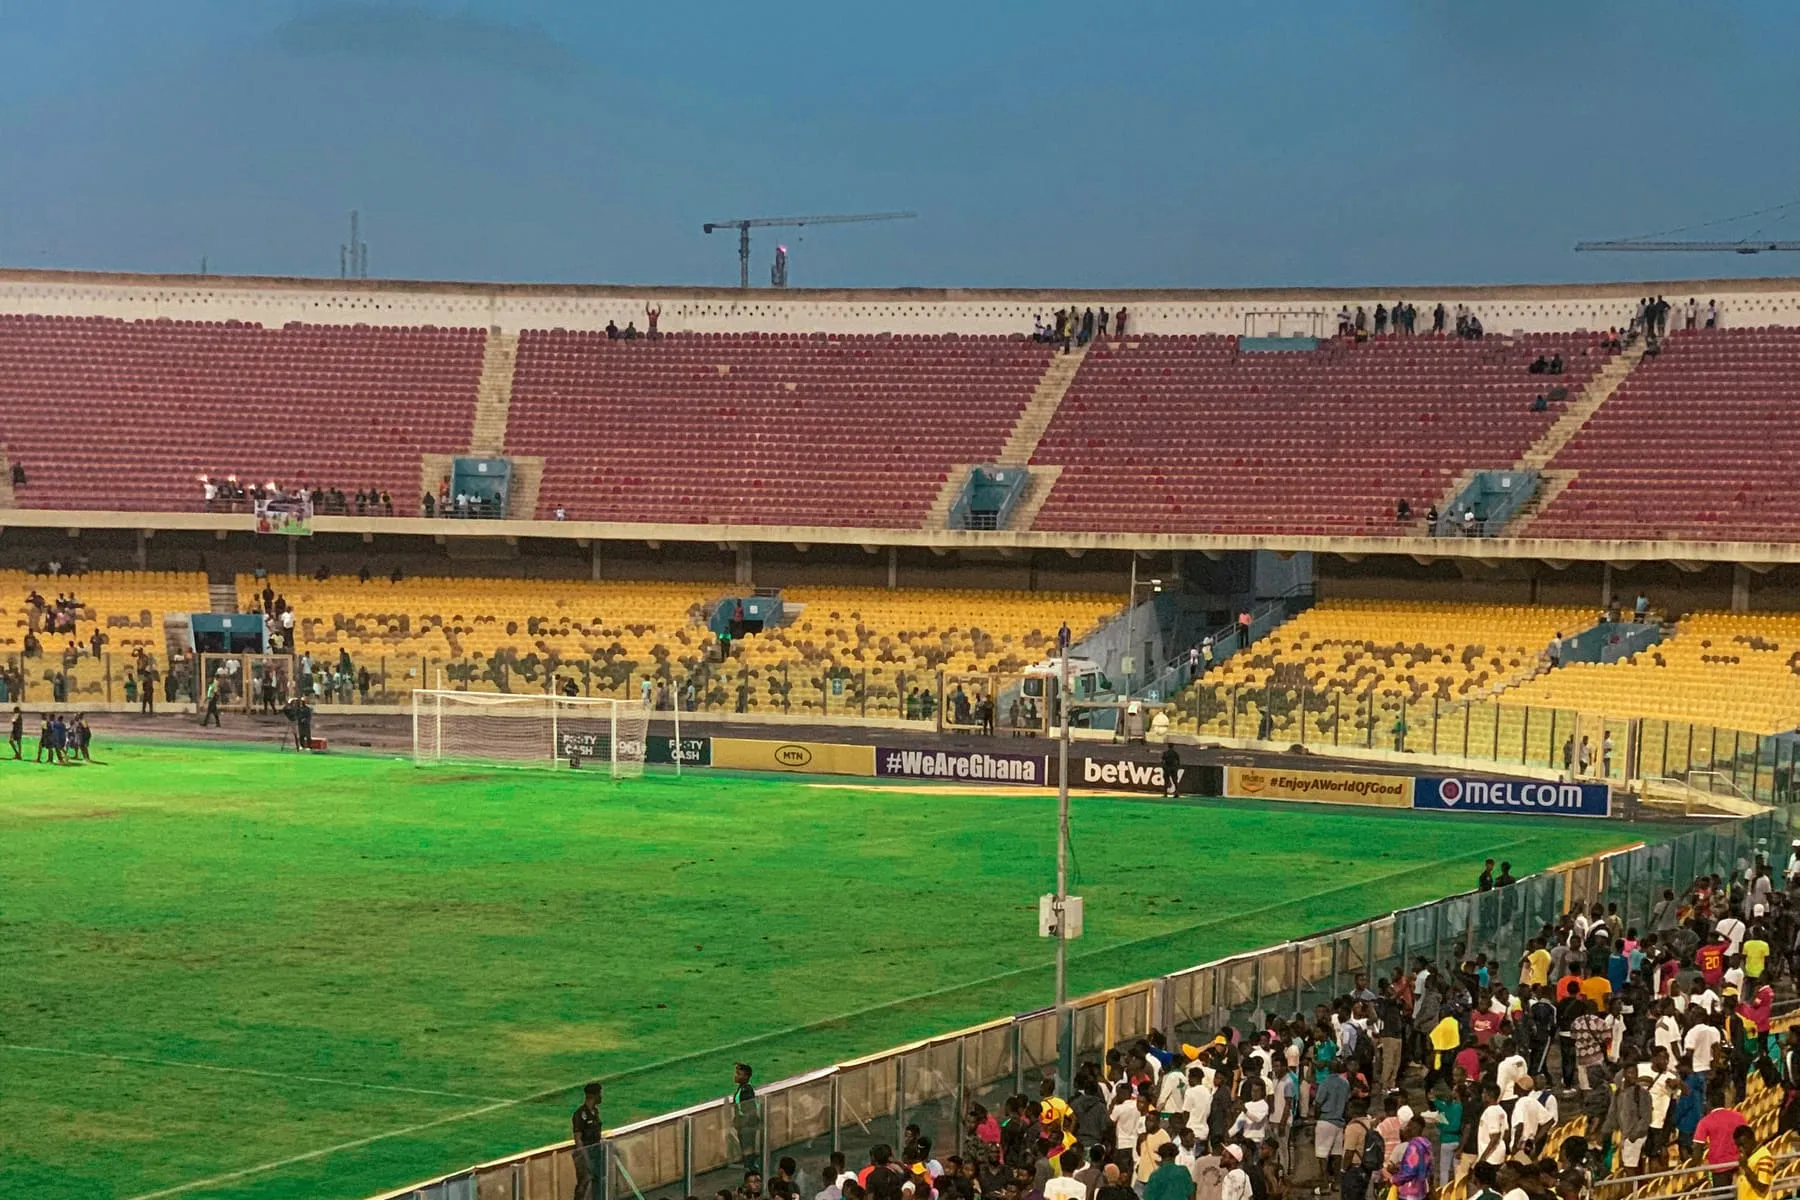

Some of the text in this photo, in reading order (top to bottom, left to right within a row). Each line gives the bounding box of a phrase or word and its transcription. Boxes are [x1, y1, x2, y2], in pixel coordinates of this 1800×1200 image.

[565, 744, 592, 755] CASH
[671, 750, 699, 760] CASH
[783, 751, 803, 761] MTN
[886, 751, 1035, 781] #WeAreGhana
[1270, 776, 1403, 796] #EnjoyAWorldOfGood
[1465, 782, 1582, 808] MELCOM
[1704, 956, 1720, 970] 20
